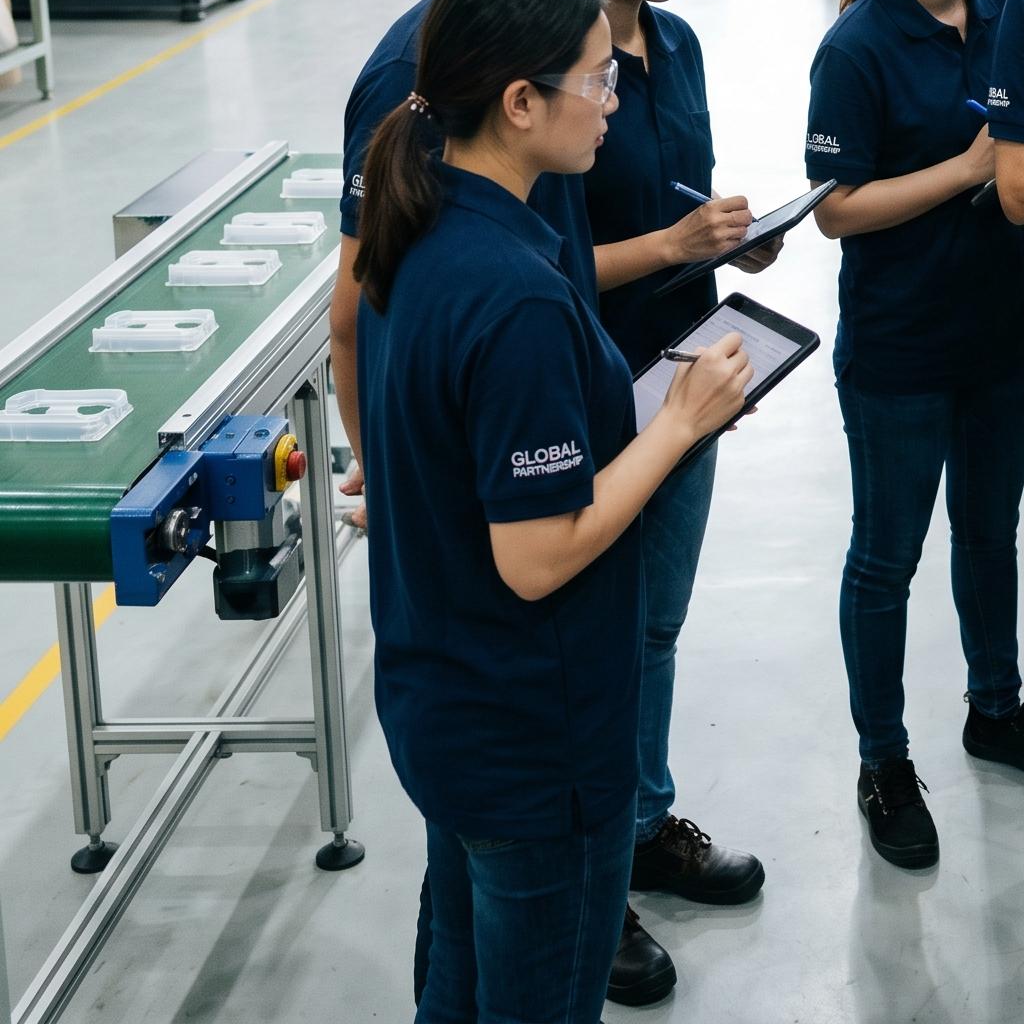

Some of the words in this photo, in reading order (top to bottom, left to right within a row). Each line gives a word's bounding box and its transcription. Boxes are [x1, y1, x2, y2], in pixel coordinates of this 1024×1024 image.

[807, 132, 840, 147] LOBAL
[511, 440, 581, 467] GLOBAL
[512, 454, 584, 477] PARTNERSHIP
